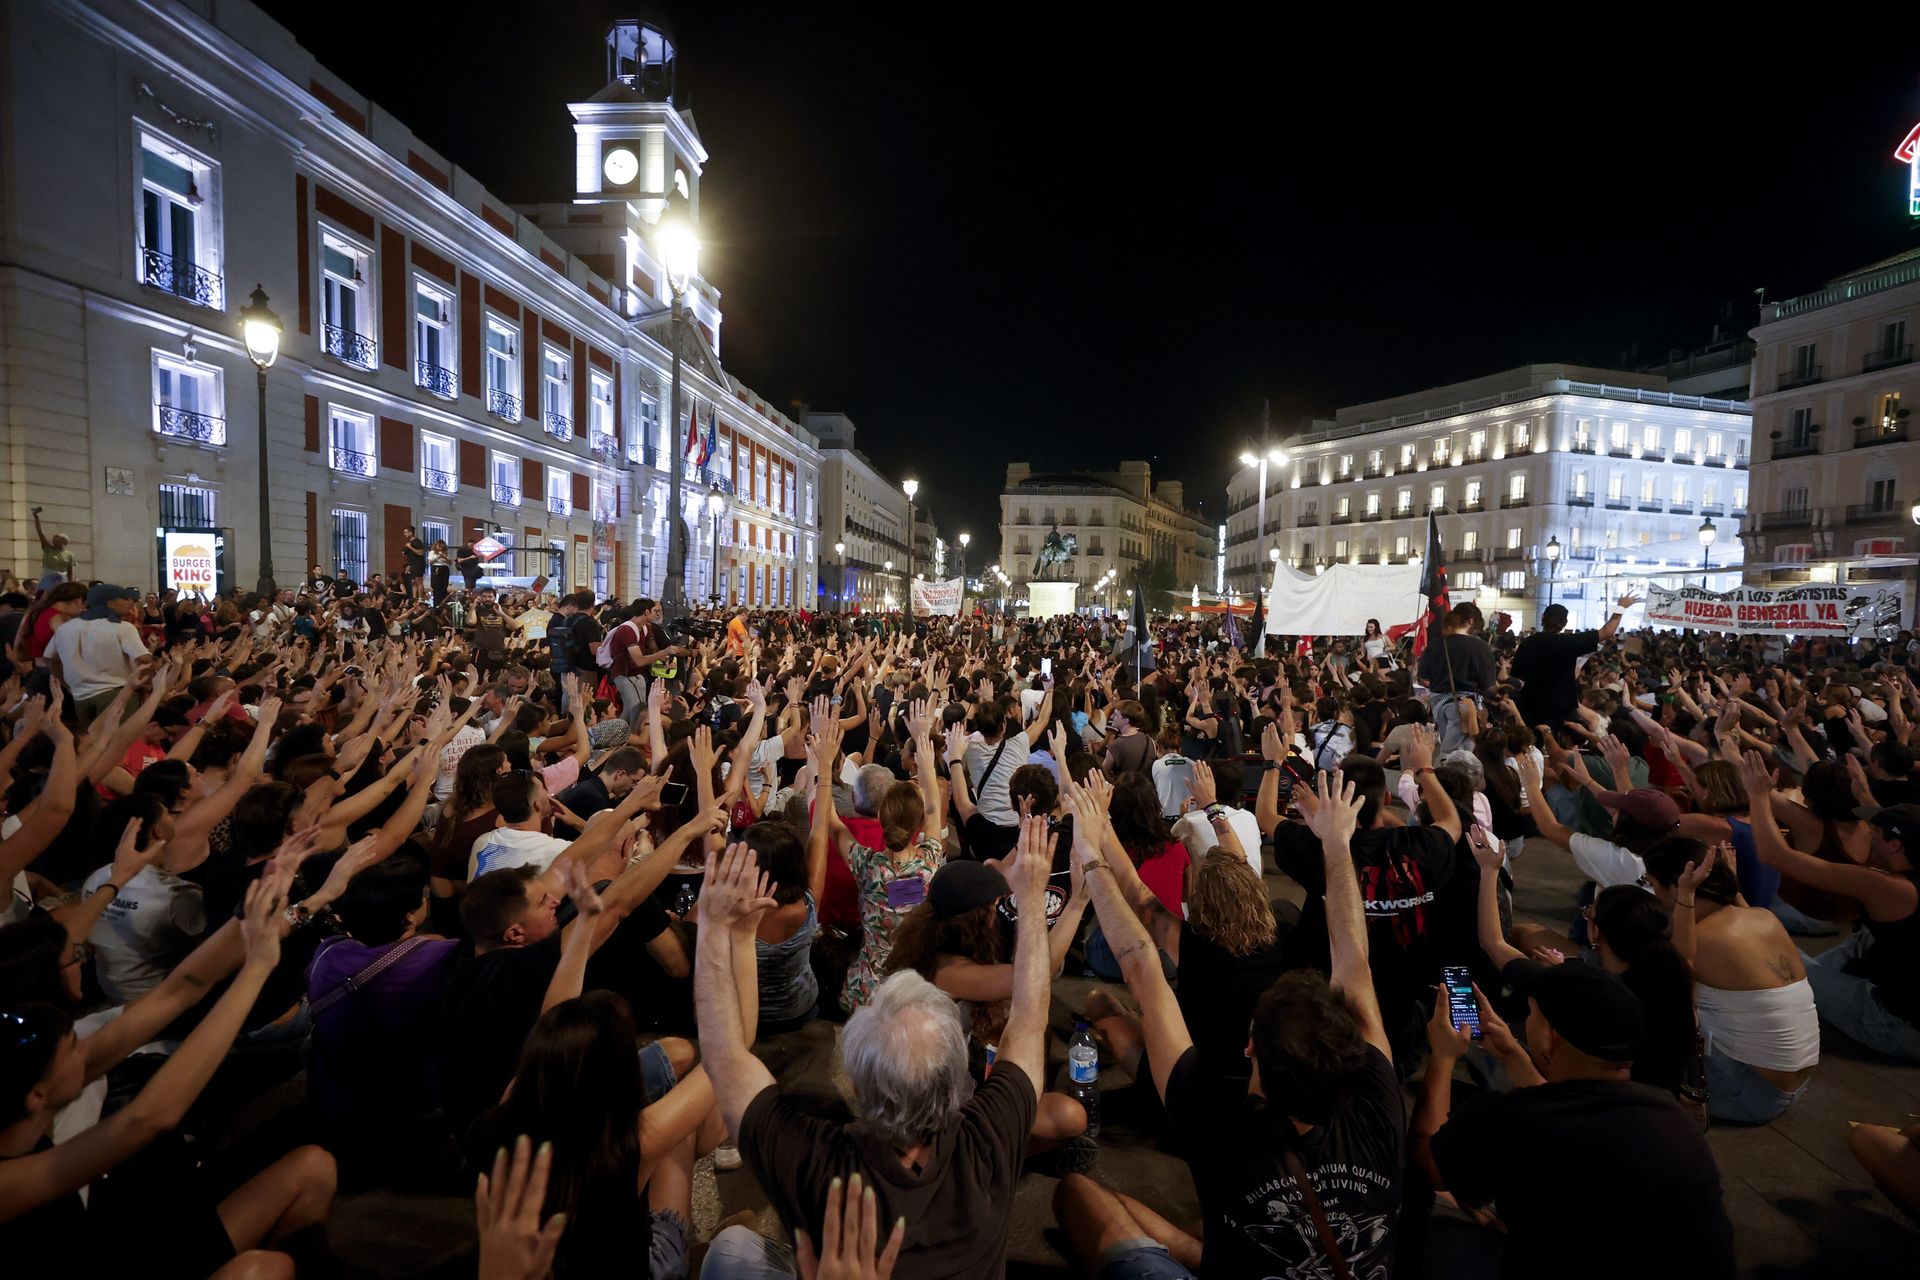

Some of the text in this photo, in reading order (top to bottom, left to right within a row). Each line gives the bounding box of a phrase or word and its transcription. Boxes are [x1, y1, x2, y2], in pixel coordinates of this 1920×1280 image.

[173, 559, 211, 568] BURGER
[173, 569, 211, 581] KING
[1747, 590, 1773, 602] LOS
[1684, 601, 1839, 620] HUELGA GENERAL YA
[1362, 891, 1433, 909] KWORKS
[1246, 1175, 1298, 1204] BILLABON
[1306, 1163, 1347, 1181] PRMIUM
[1331, 1179, 1368, 1194] LIVING
